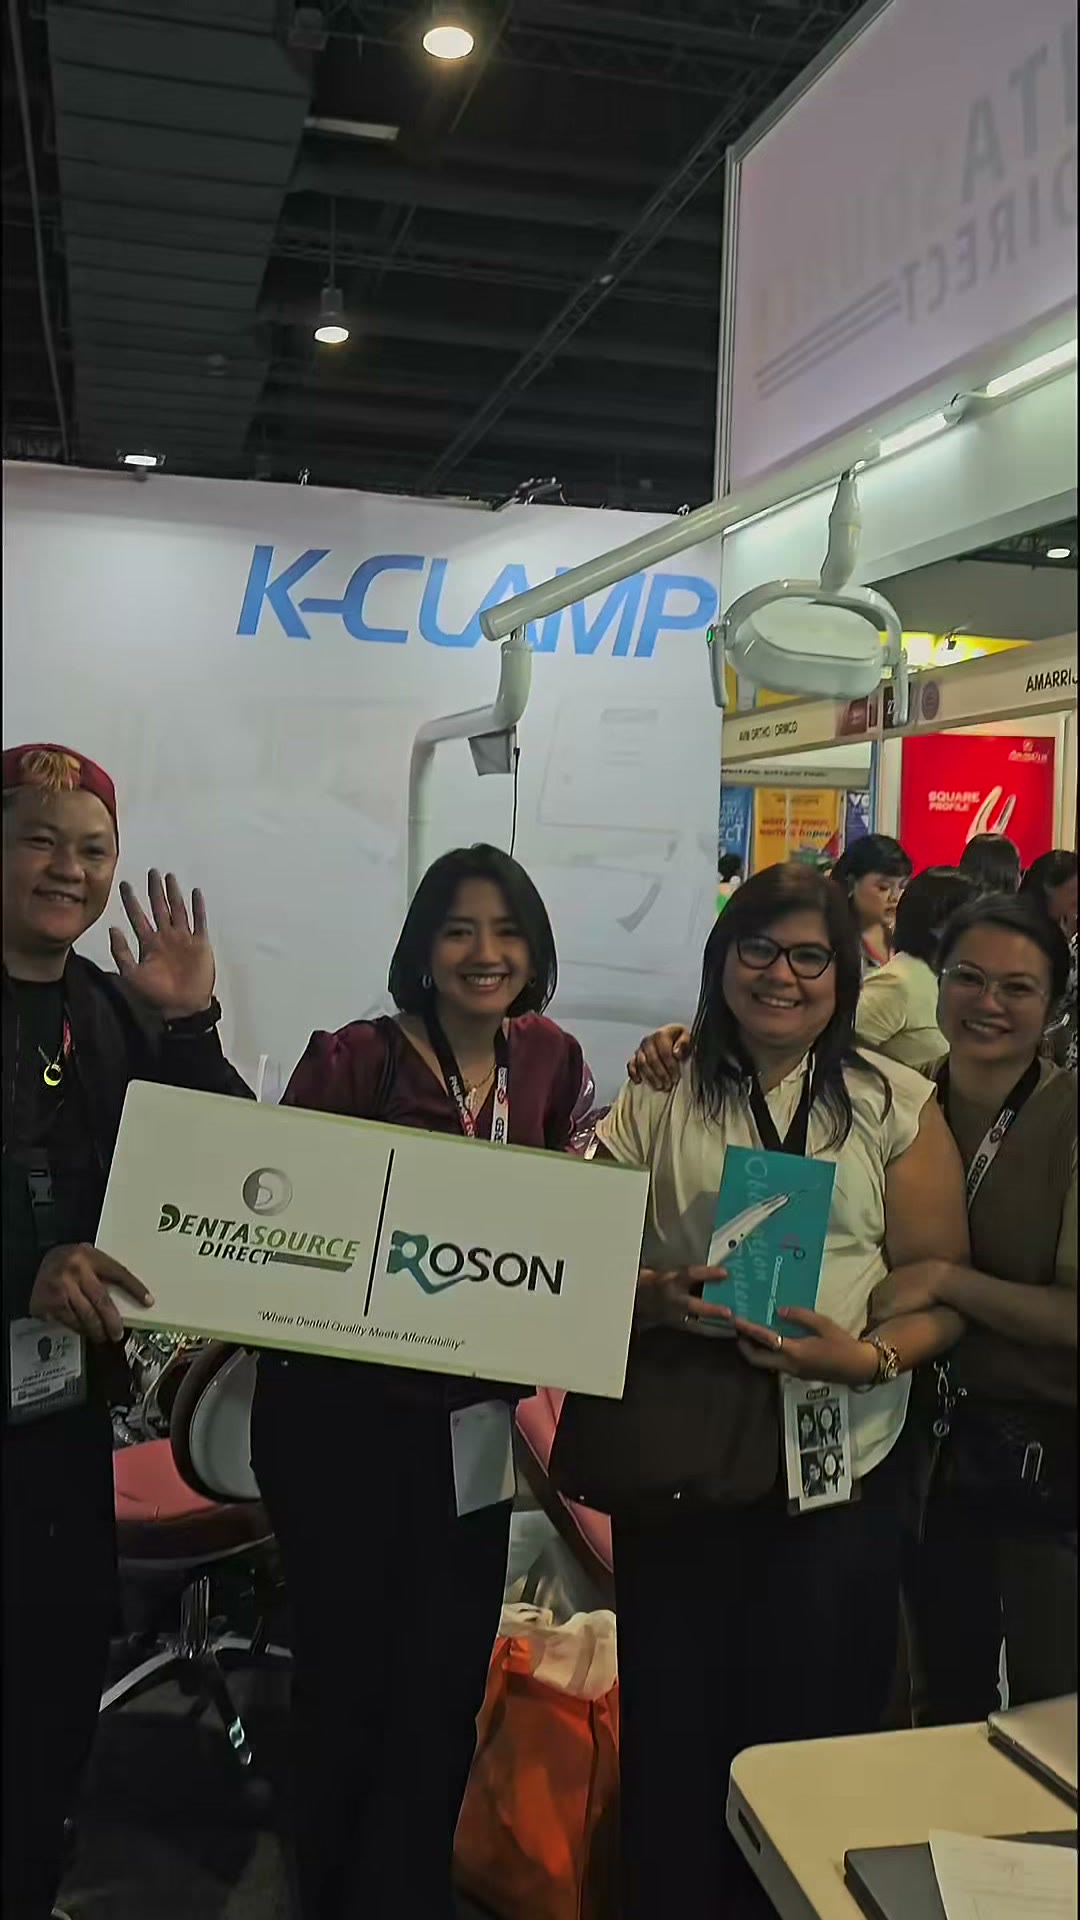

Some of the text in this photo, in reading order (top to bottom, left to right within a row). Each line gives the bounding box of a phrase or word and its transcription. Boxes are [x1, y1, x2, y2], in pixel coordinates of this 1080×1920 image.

[928, 790, 980, 803] SQUARE
[928, 803, 970, 812] PROFILE
[157, 1203, 361, 1260] DENTASOURCE
[198, 1240, 276, 1265] DIRECT
[386, 1230, 564, 1295] ROSON
[296, 1315, 330, 1329] Dental
[331, 1321, 367, 1337] Quality
[368, 1326, 399, 1340] Meets
